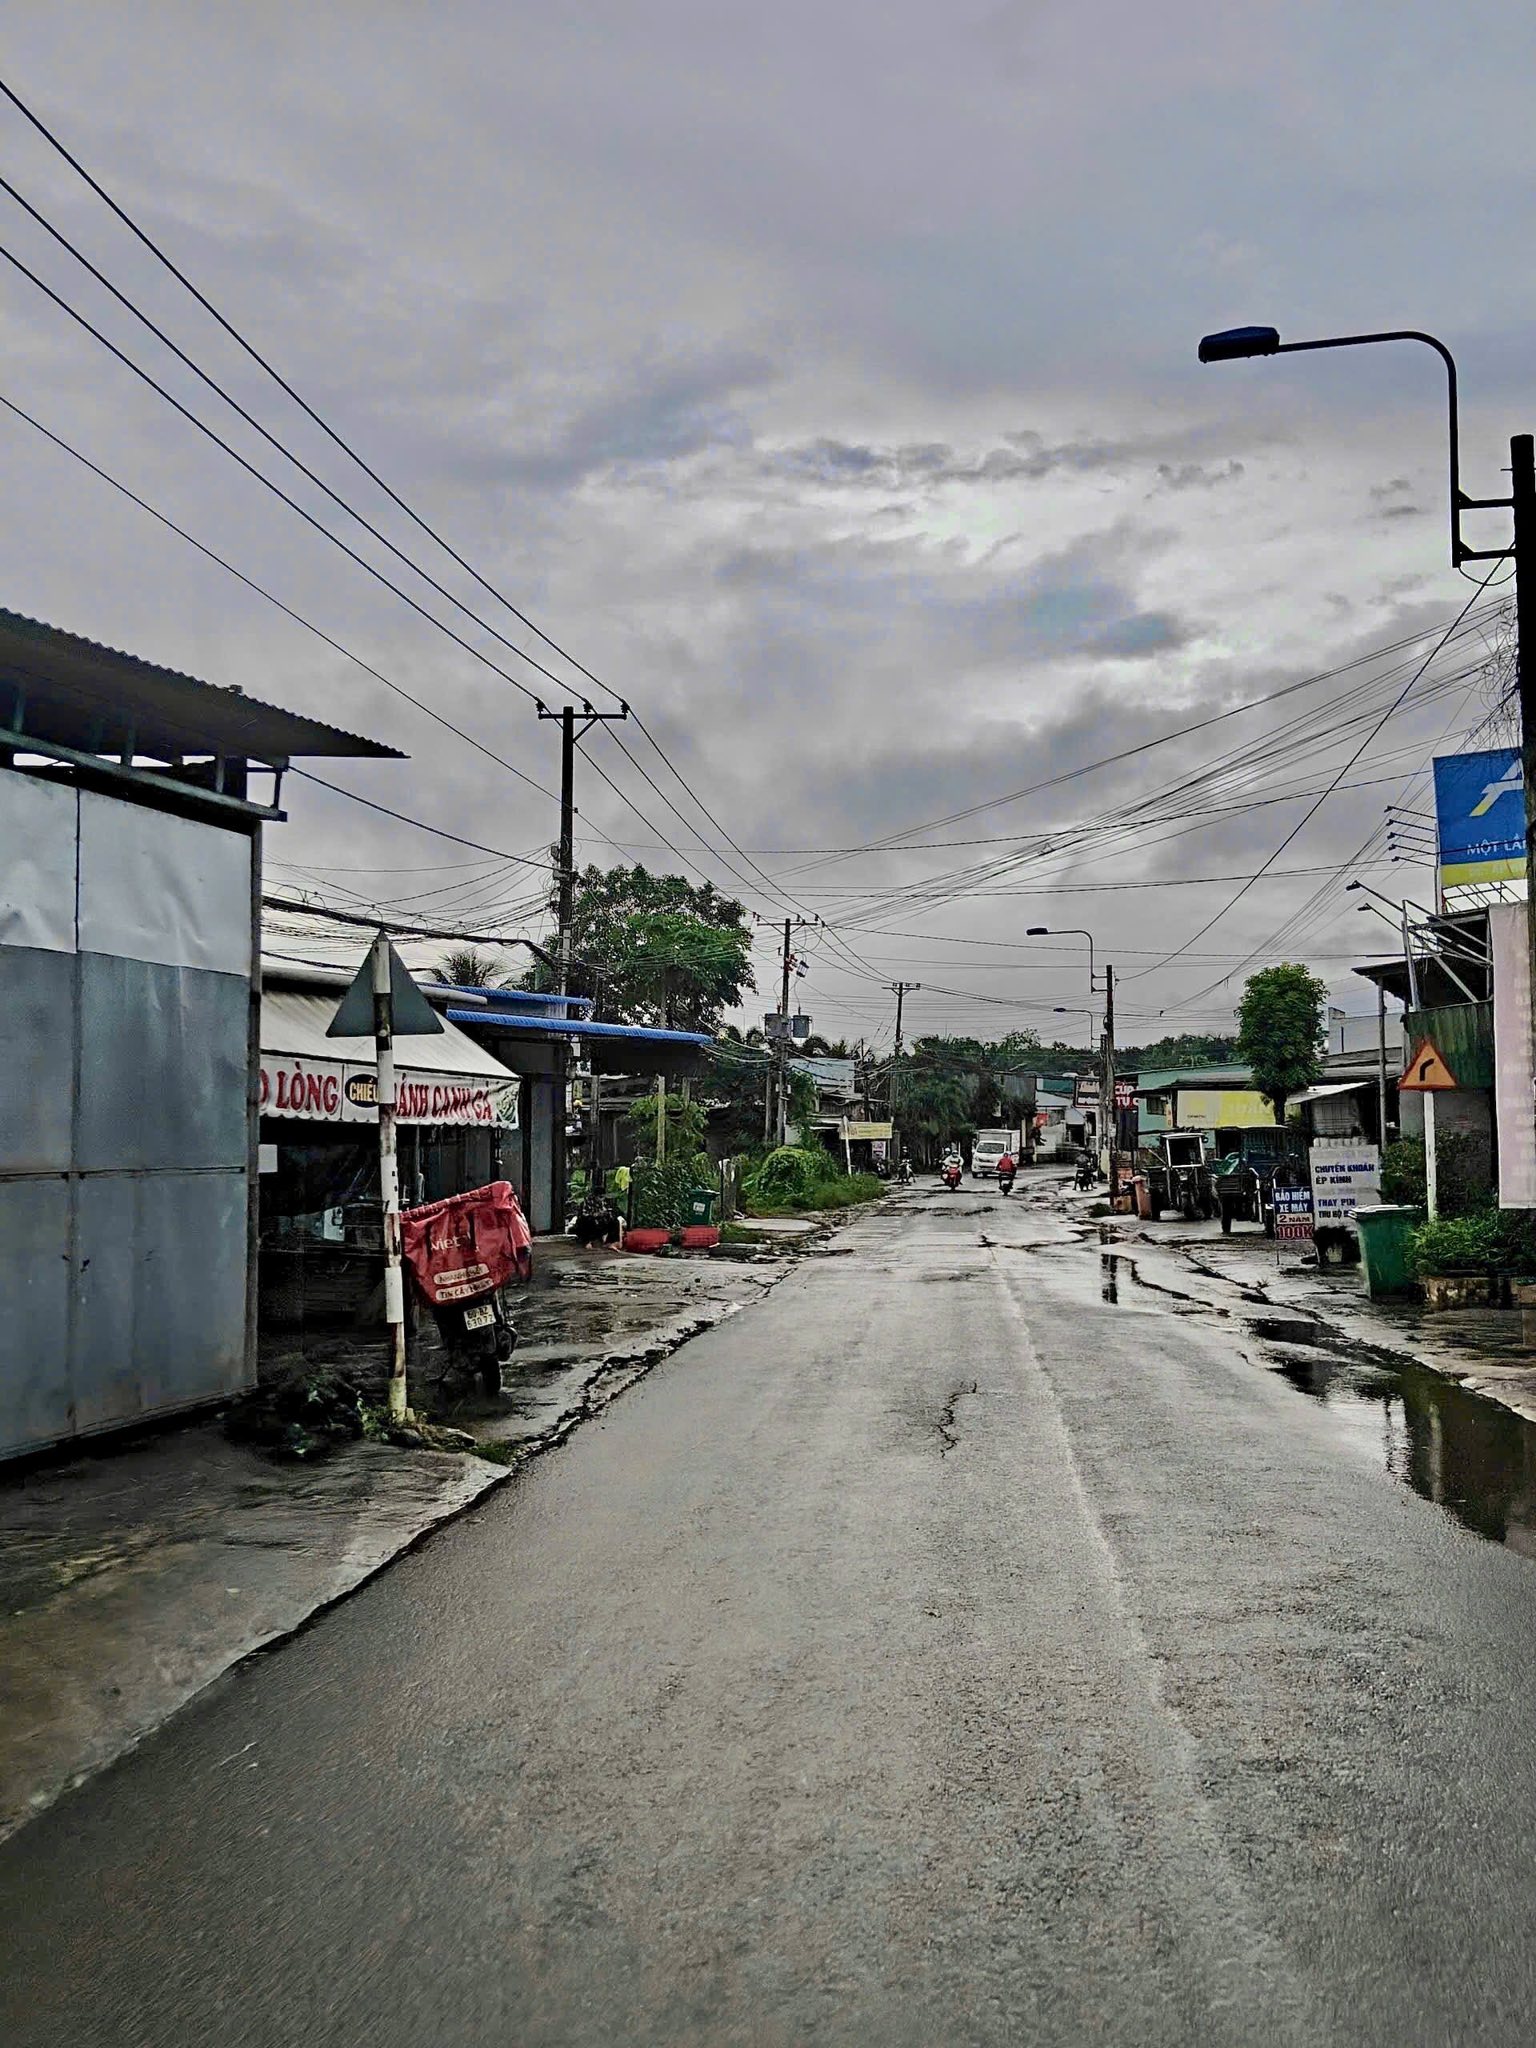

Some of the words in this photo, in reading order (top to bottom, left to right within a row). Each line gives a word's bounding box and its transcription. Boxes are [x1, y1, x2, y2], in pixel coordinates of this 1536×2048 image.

[1467, 839, 1499, 855] MỘT
[276, 1061, 338, 1113] LÒNG
[394, 1072, 429, 1117] ÁNH
[431, 1083, 471, 1119] CANH
[1275, 1188, 1290, 1202] BẢO
[1278, 1203, 1290, 1213] XE
[1291, 1202, 1308, 1213] MÁY
[1318, 1198, 1339, 1207] THAY
[1341, 1198, 1356, 1207] PIN
[1279, 1214, 1288, 1223] 2
[1276, 1225, 1314, 1240] 100K
